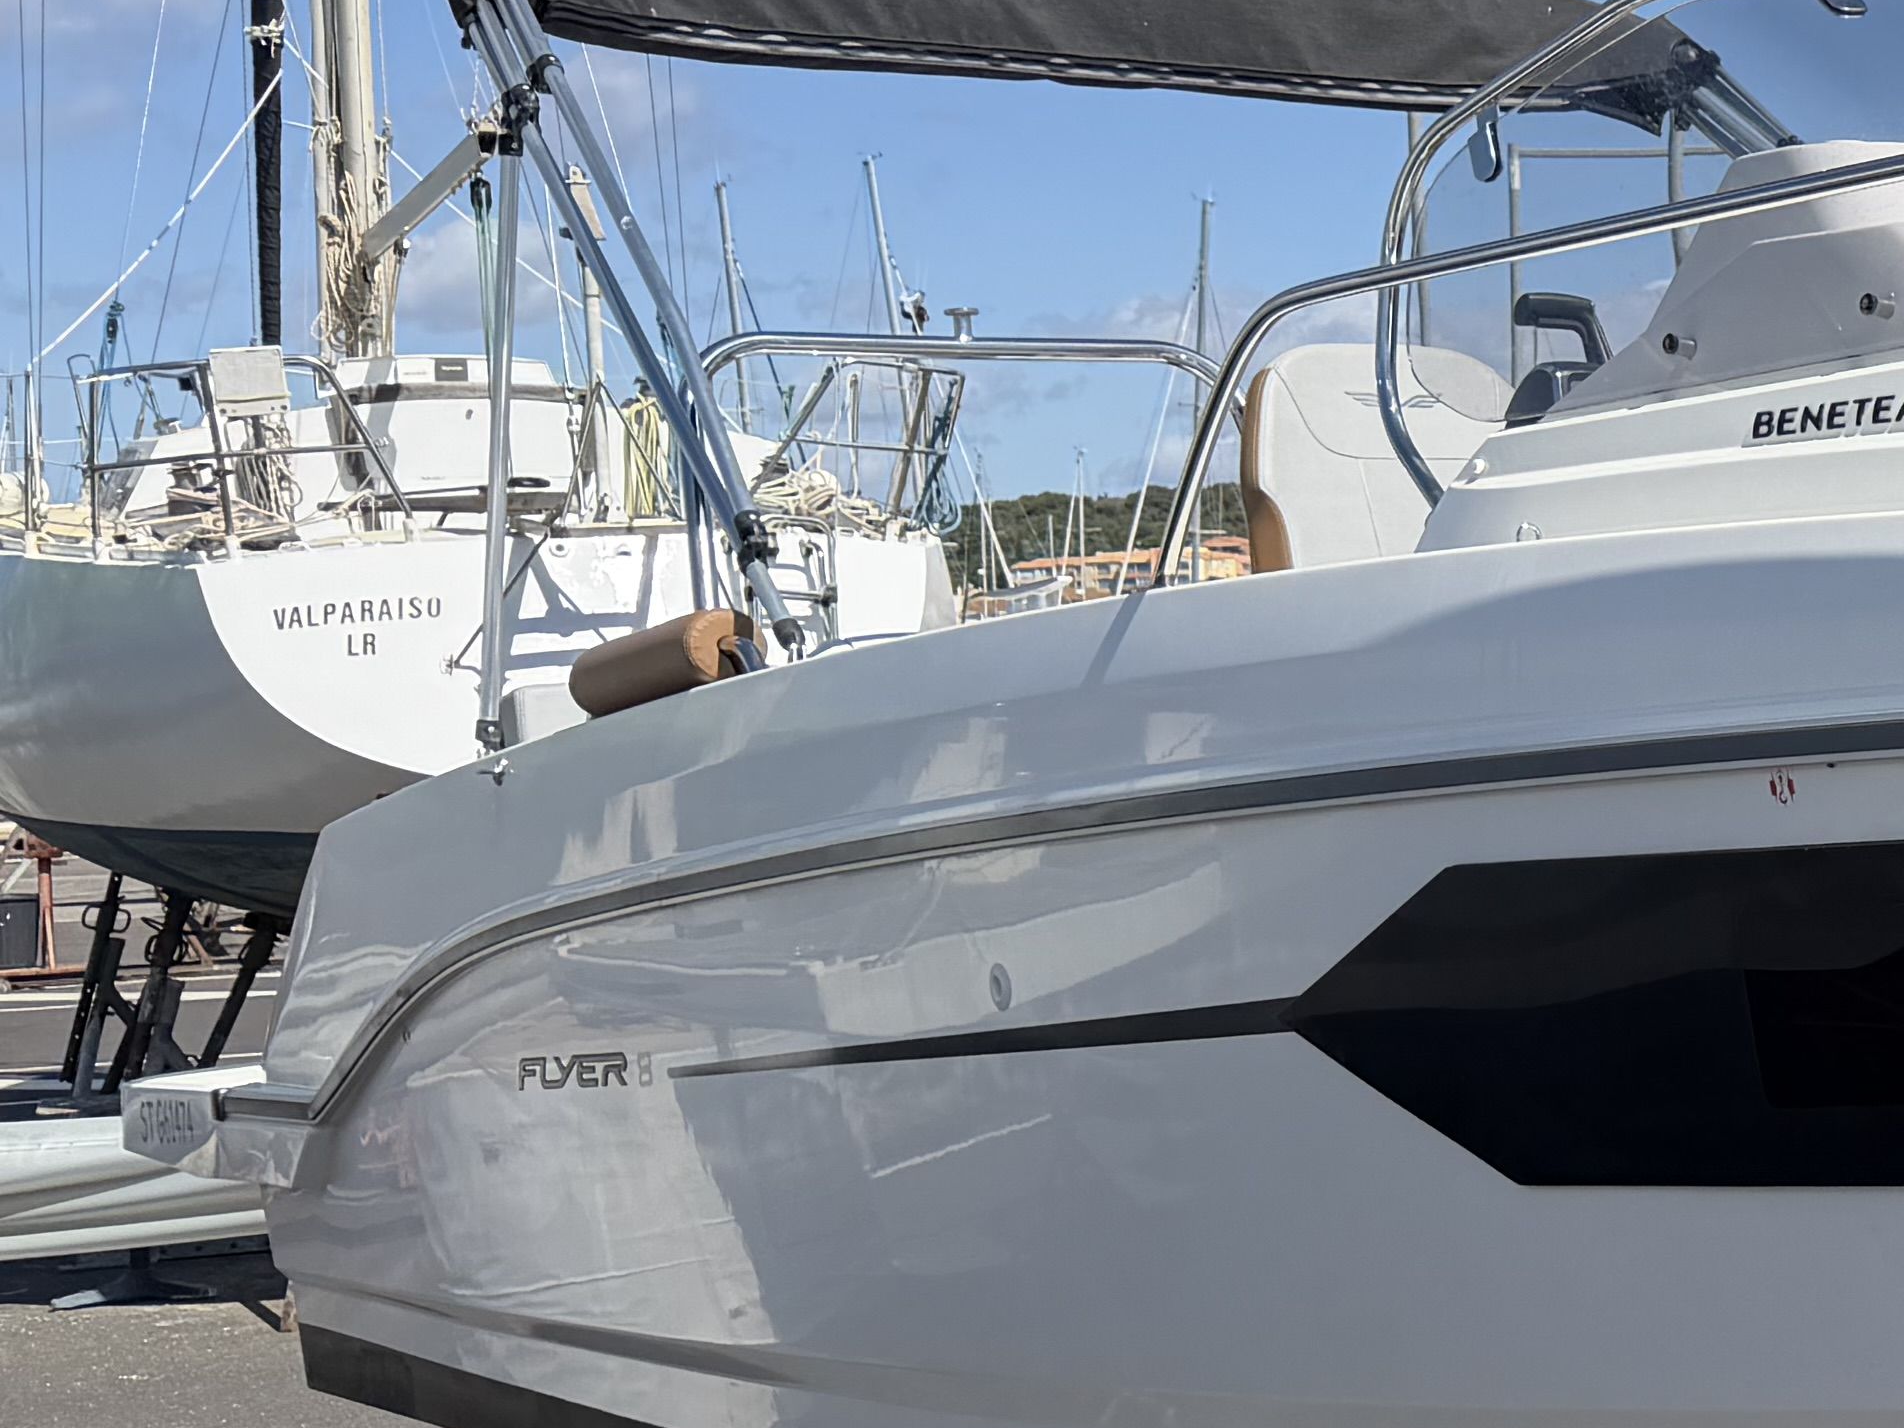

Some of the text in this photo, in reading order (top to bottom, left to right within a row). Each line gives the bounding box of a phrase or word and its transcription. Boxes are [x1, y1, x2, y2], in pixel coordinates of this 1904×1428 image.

[273, 597, 441, 630] VALPARAISO
[347, 633, 376, 656] LR
[519, 1052, 628, 1091] FLYER
